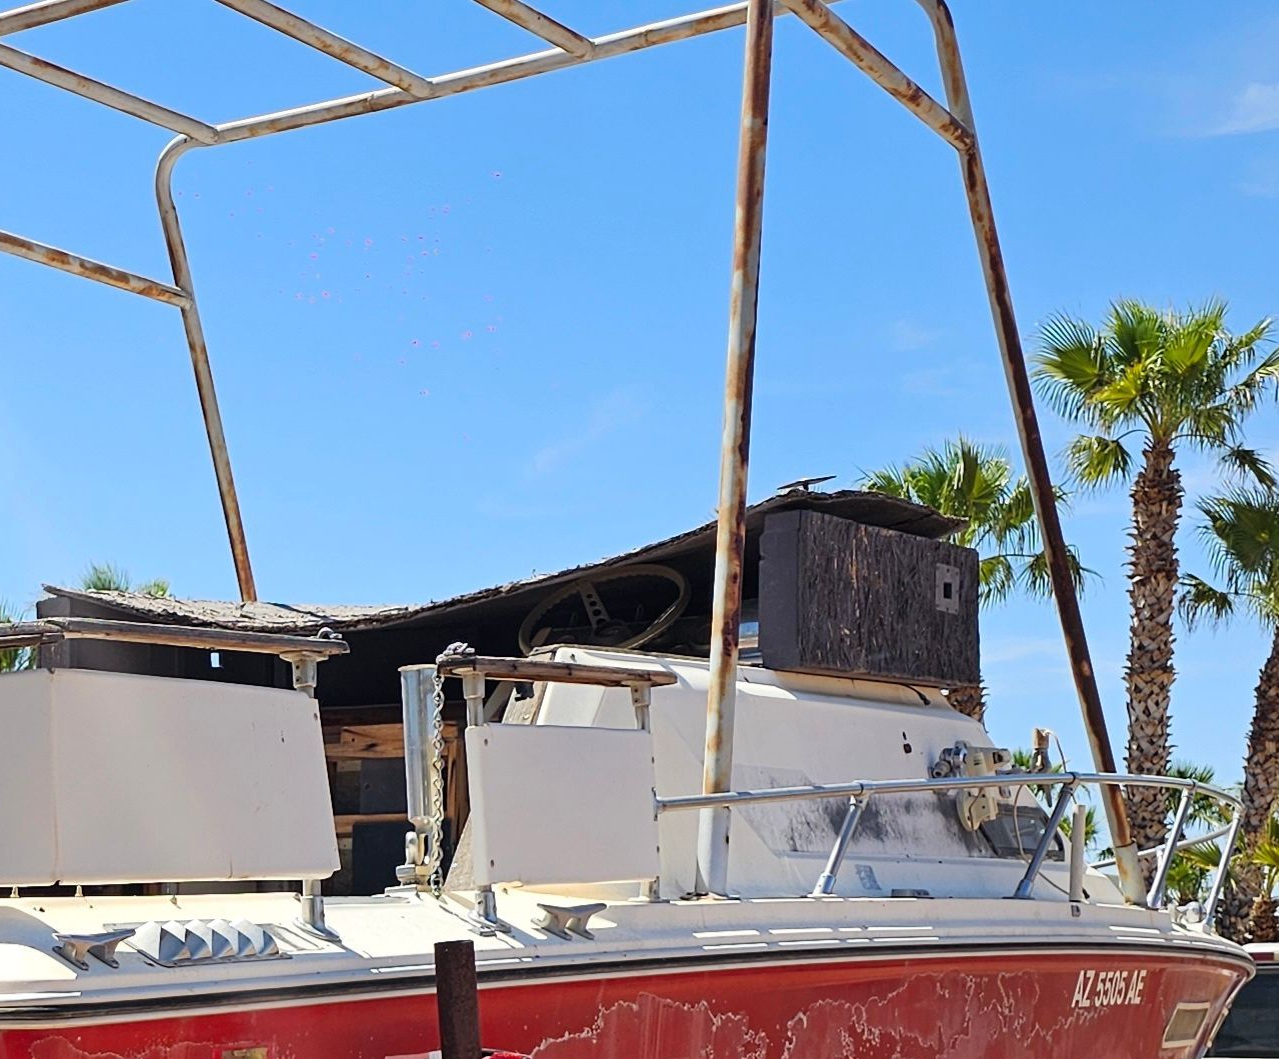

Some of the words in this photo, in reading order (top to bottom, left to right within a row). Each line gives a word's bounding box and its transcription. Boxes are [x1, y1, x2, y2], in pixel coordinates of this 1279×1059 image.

[1071, 969, 1095, 1008] AZ
[1094, 971, 1128, 1007] 5505
[1124, 969, 1147, 1005] AE
